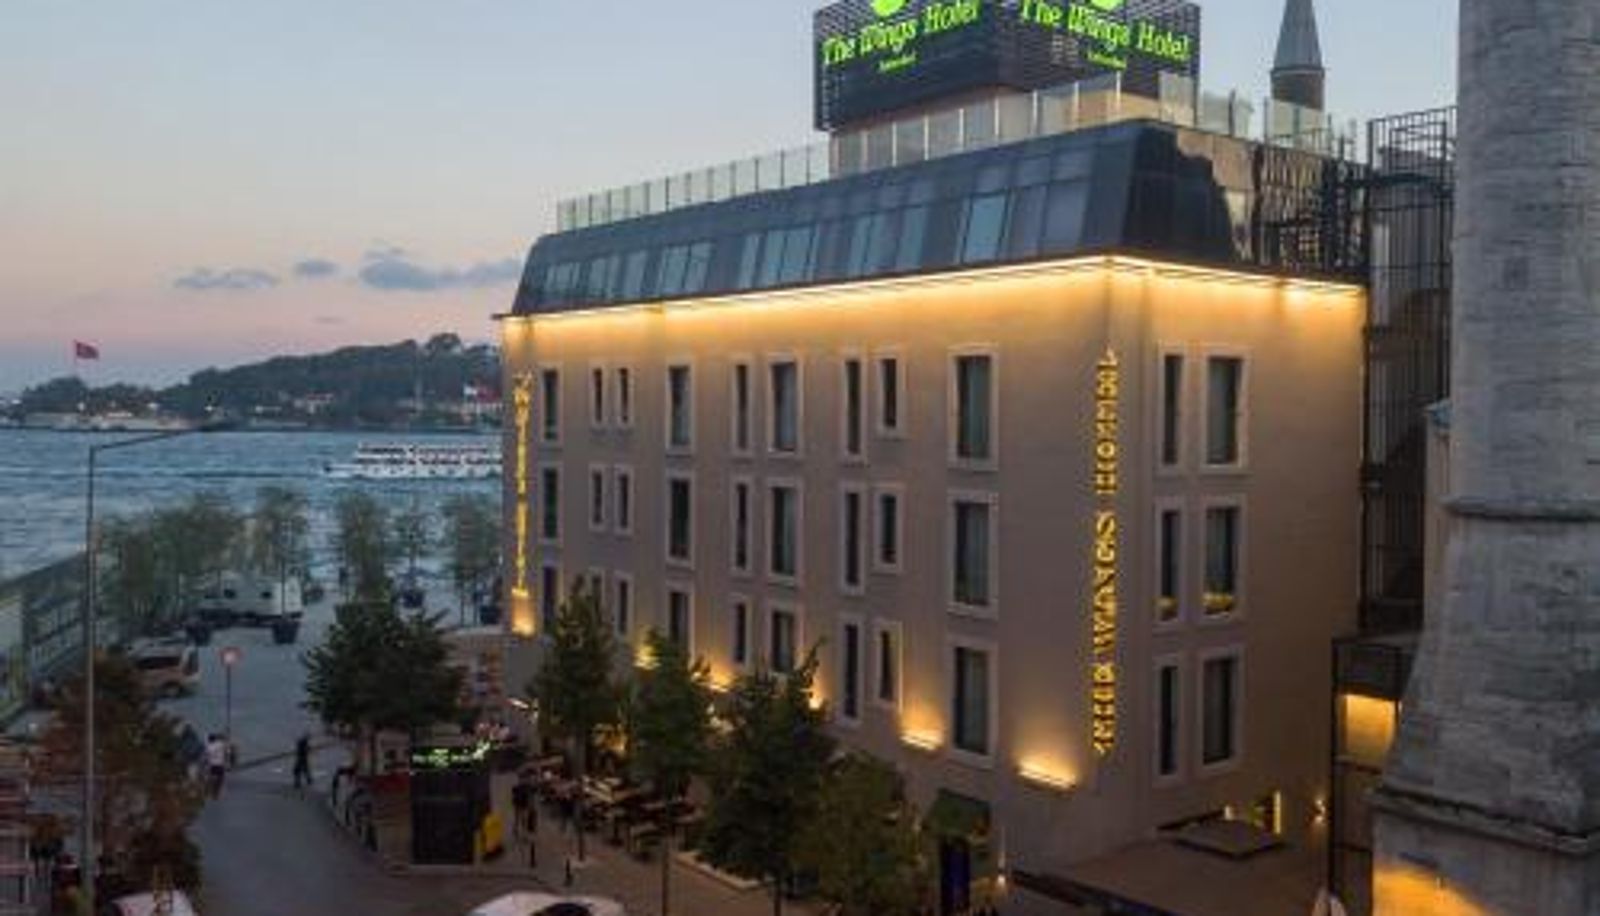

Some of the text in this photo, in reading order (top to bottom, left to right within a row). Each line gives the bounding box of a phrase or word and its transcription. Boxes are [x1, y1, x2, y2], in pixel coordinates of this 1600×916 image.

[821, 34, 855, 65] The
[924, 0, 980, 32] Hotel
[1020, 0, 1062, 25] The
[1067, 3, 1131, 51] Wings
[1136, 20, 1191, 61] Hotel
[1093, 348, 1119, 755] THE WINGS HOTEL
